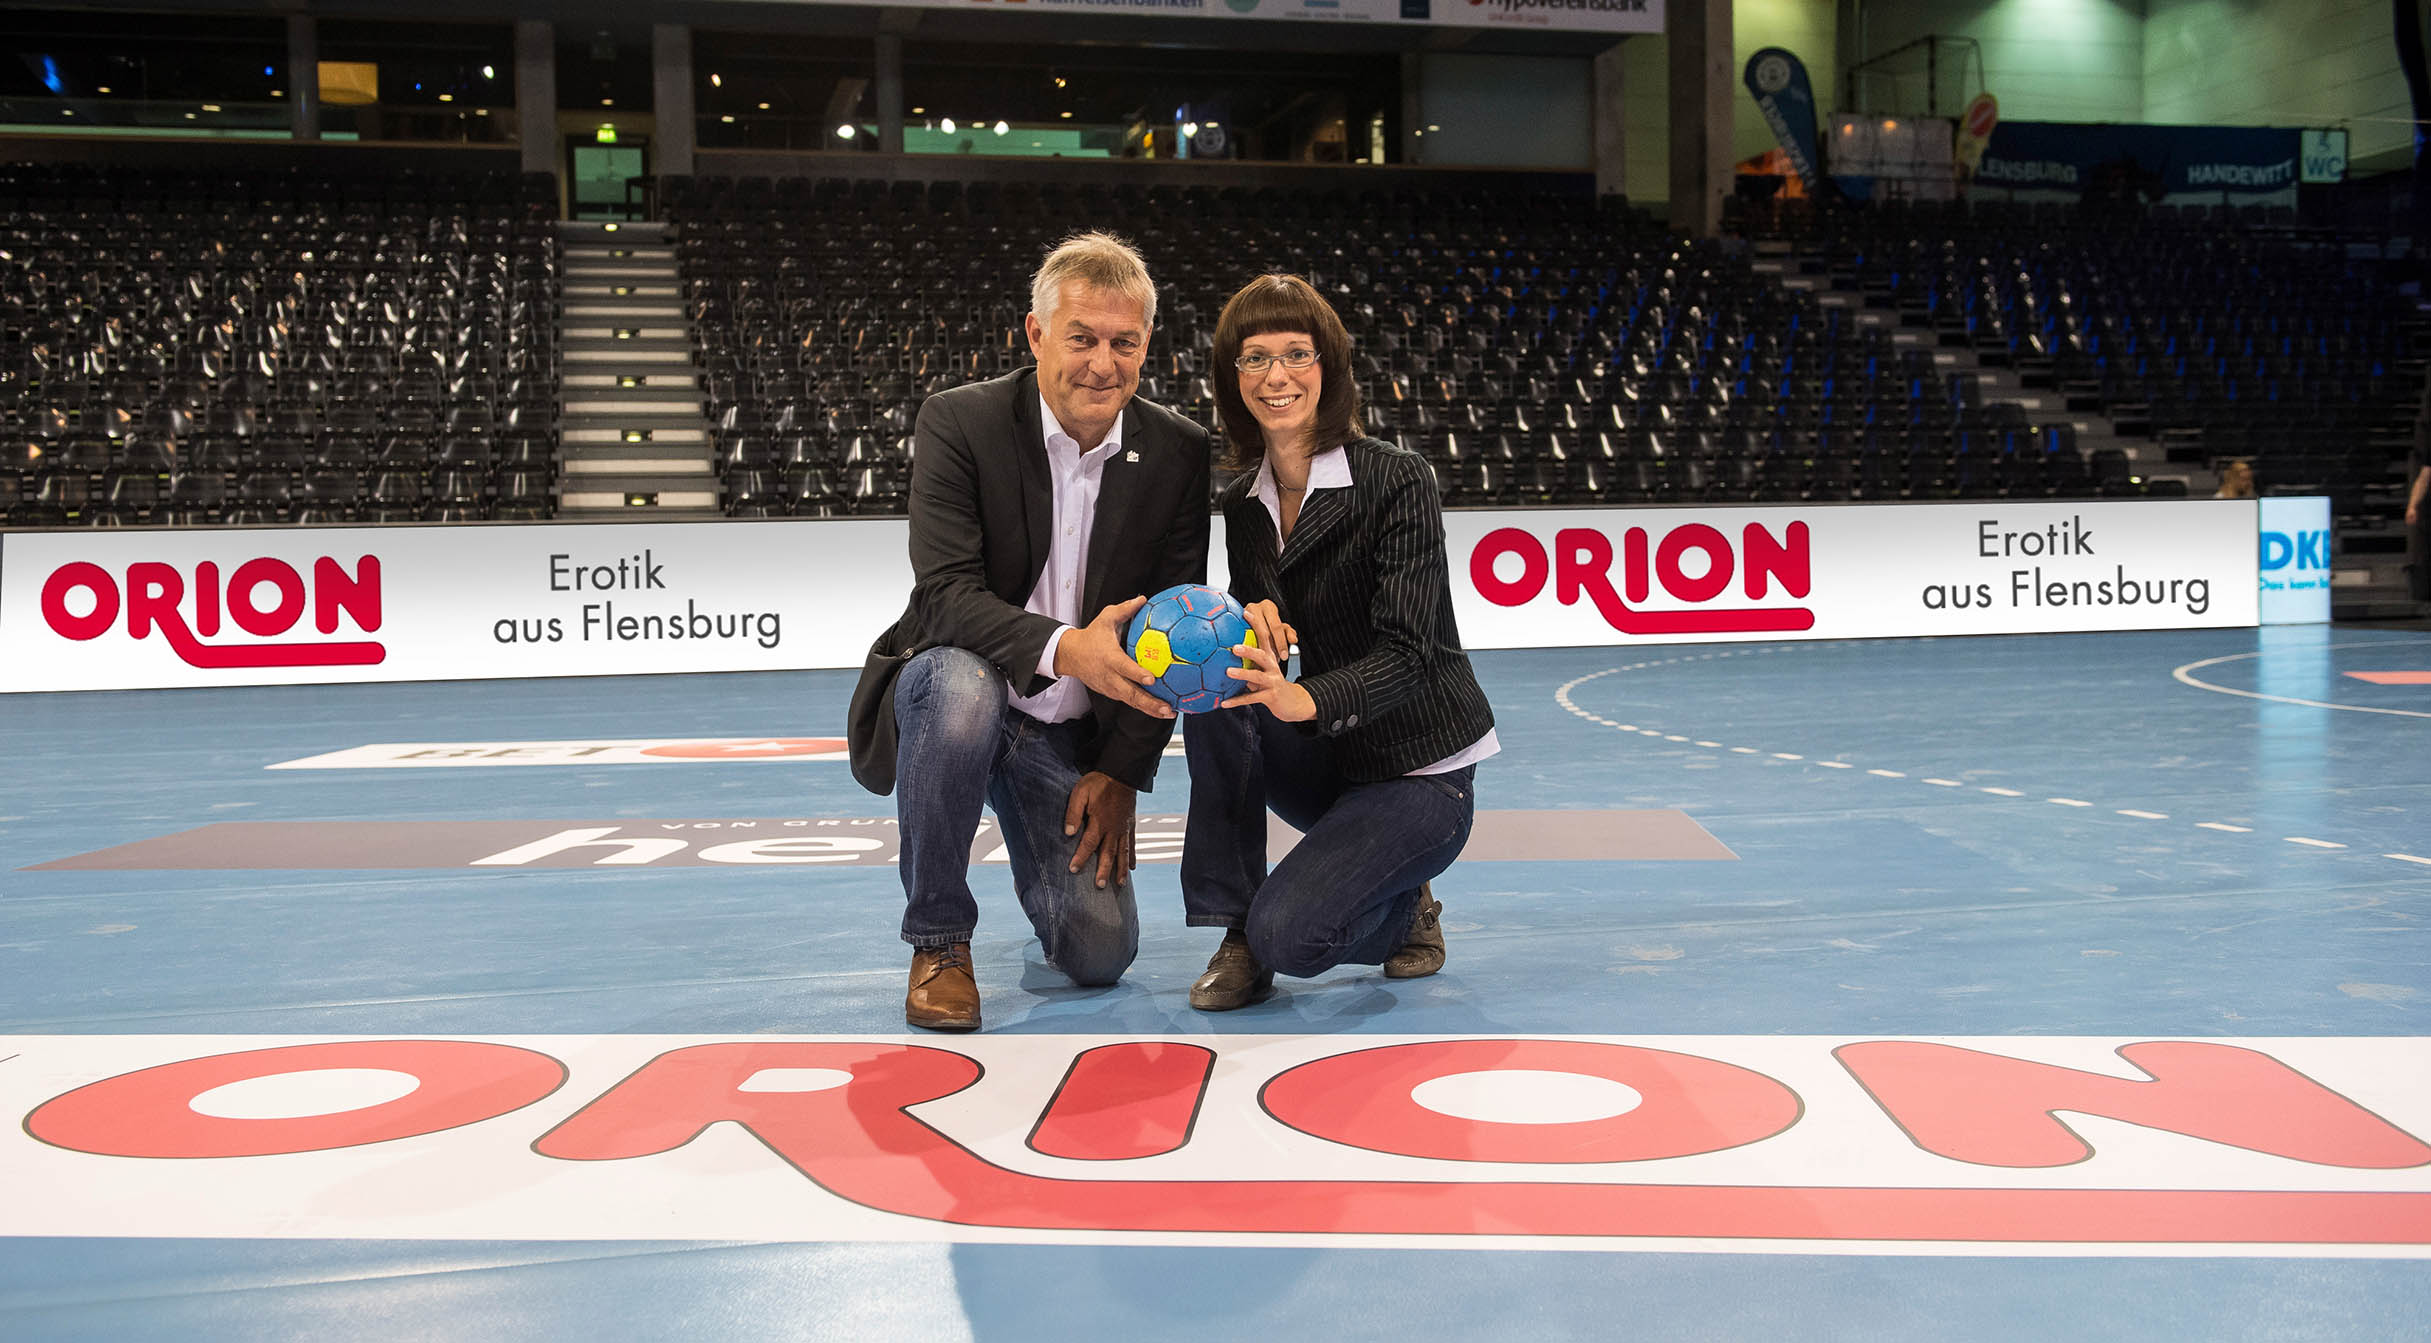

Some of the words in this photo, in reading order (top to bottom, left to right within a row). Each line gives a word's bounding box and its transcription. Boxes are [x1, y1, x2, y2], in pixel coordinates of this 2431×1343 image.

[1976, 158, 2078, 183] LENSBURG
[2187, 158, 2294, 185] HANDEWITT
[2305, 157, 2341, 176] WC
[1978, 515, 2095, 557] Erotik
[549, 549, 666, 592] Erotik
[1469, 521, 1815, 635] ORION
[1922, 584, 1992, 610] aus
[2011, 565, 2210, 615] Flensburg
[41, 555, 386, 669] ORION
[493, 617, 563, 644] aus
[582, 599, 782, 649] Flensburg
[661, 822, 757, 830] VON
[22, 1039, 2431, 1242] ORION
